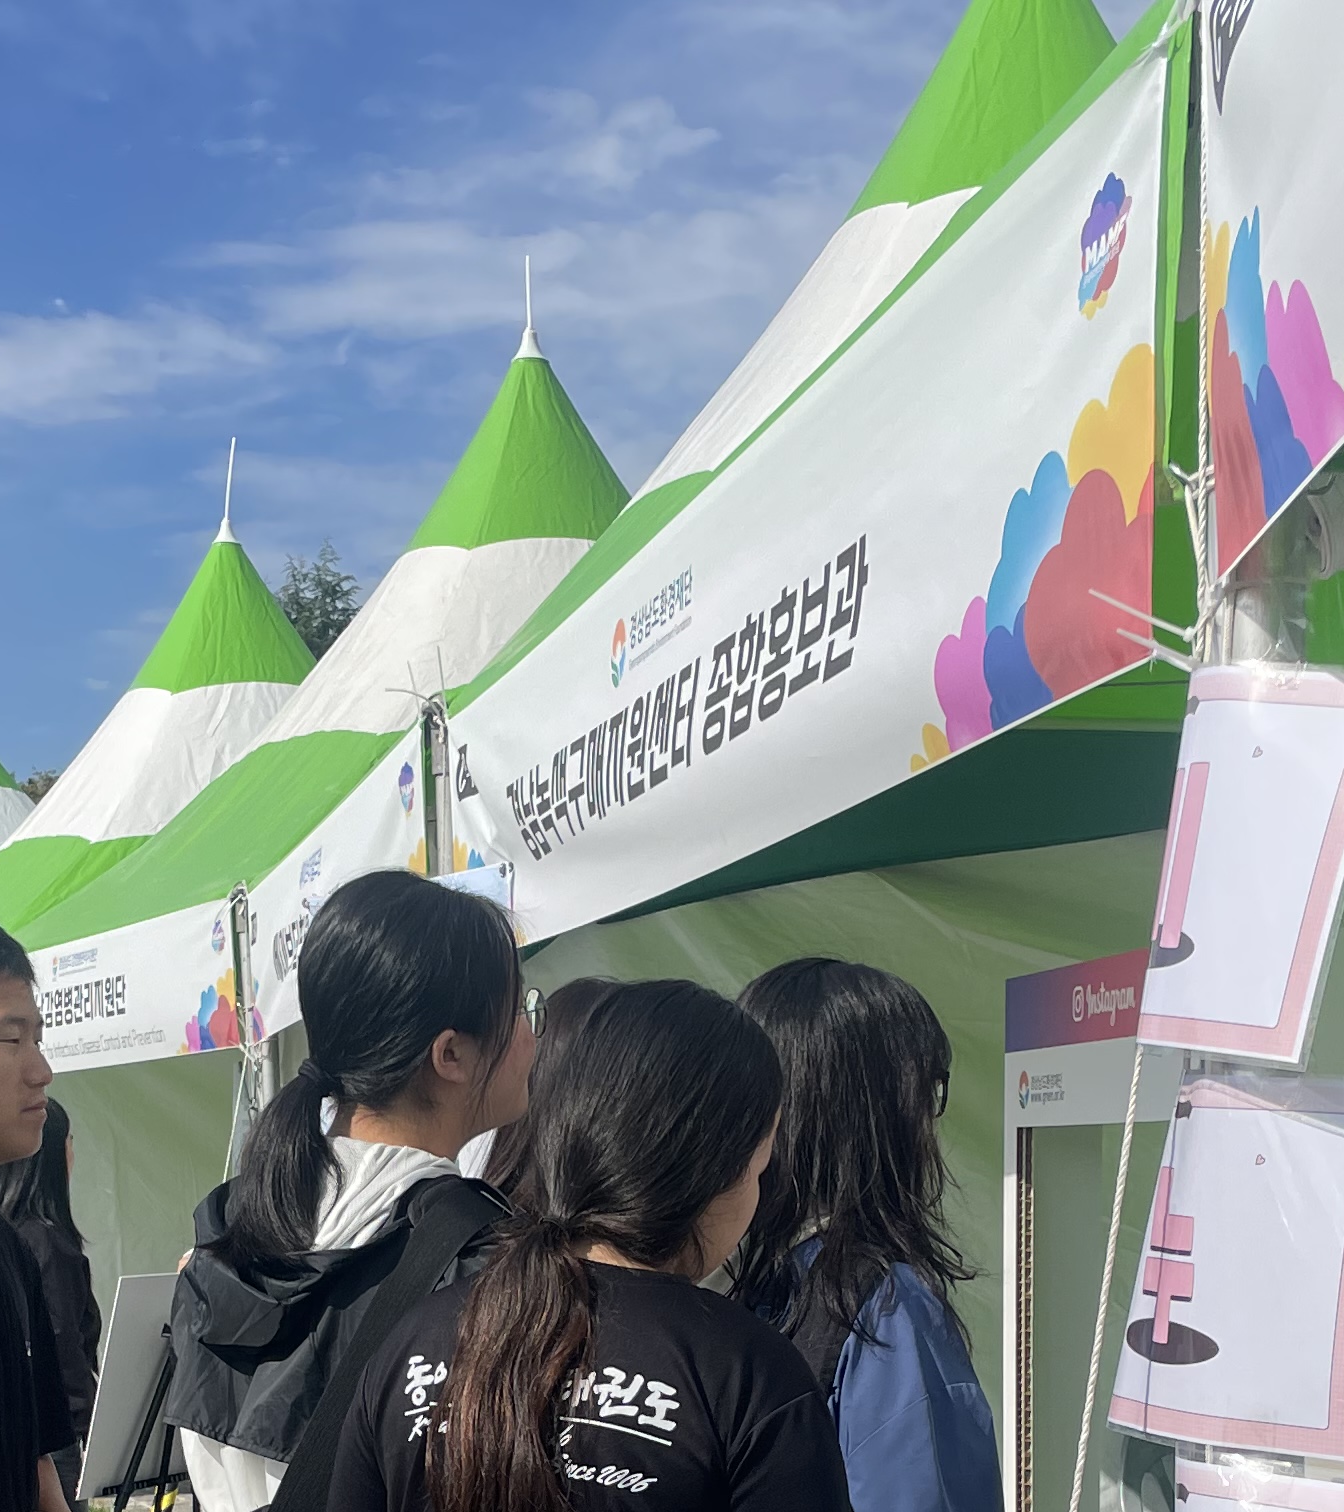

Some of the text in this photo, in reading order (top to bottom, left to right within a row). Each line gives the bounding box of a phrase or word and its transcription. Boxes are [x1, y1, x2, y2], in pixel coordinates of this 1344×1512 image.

[629, 564, 693, 649] 경상남도환경재단
[506, 533, 869, 861] 경남녹색구매지원센터 종합홍보관
[1086, 982, 1136, 1026] Instagram
[561, 1453, 658, 1493] ince 2006
